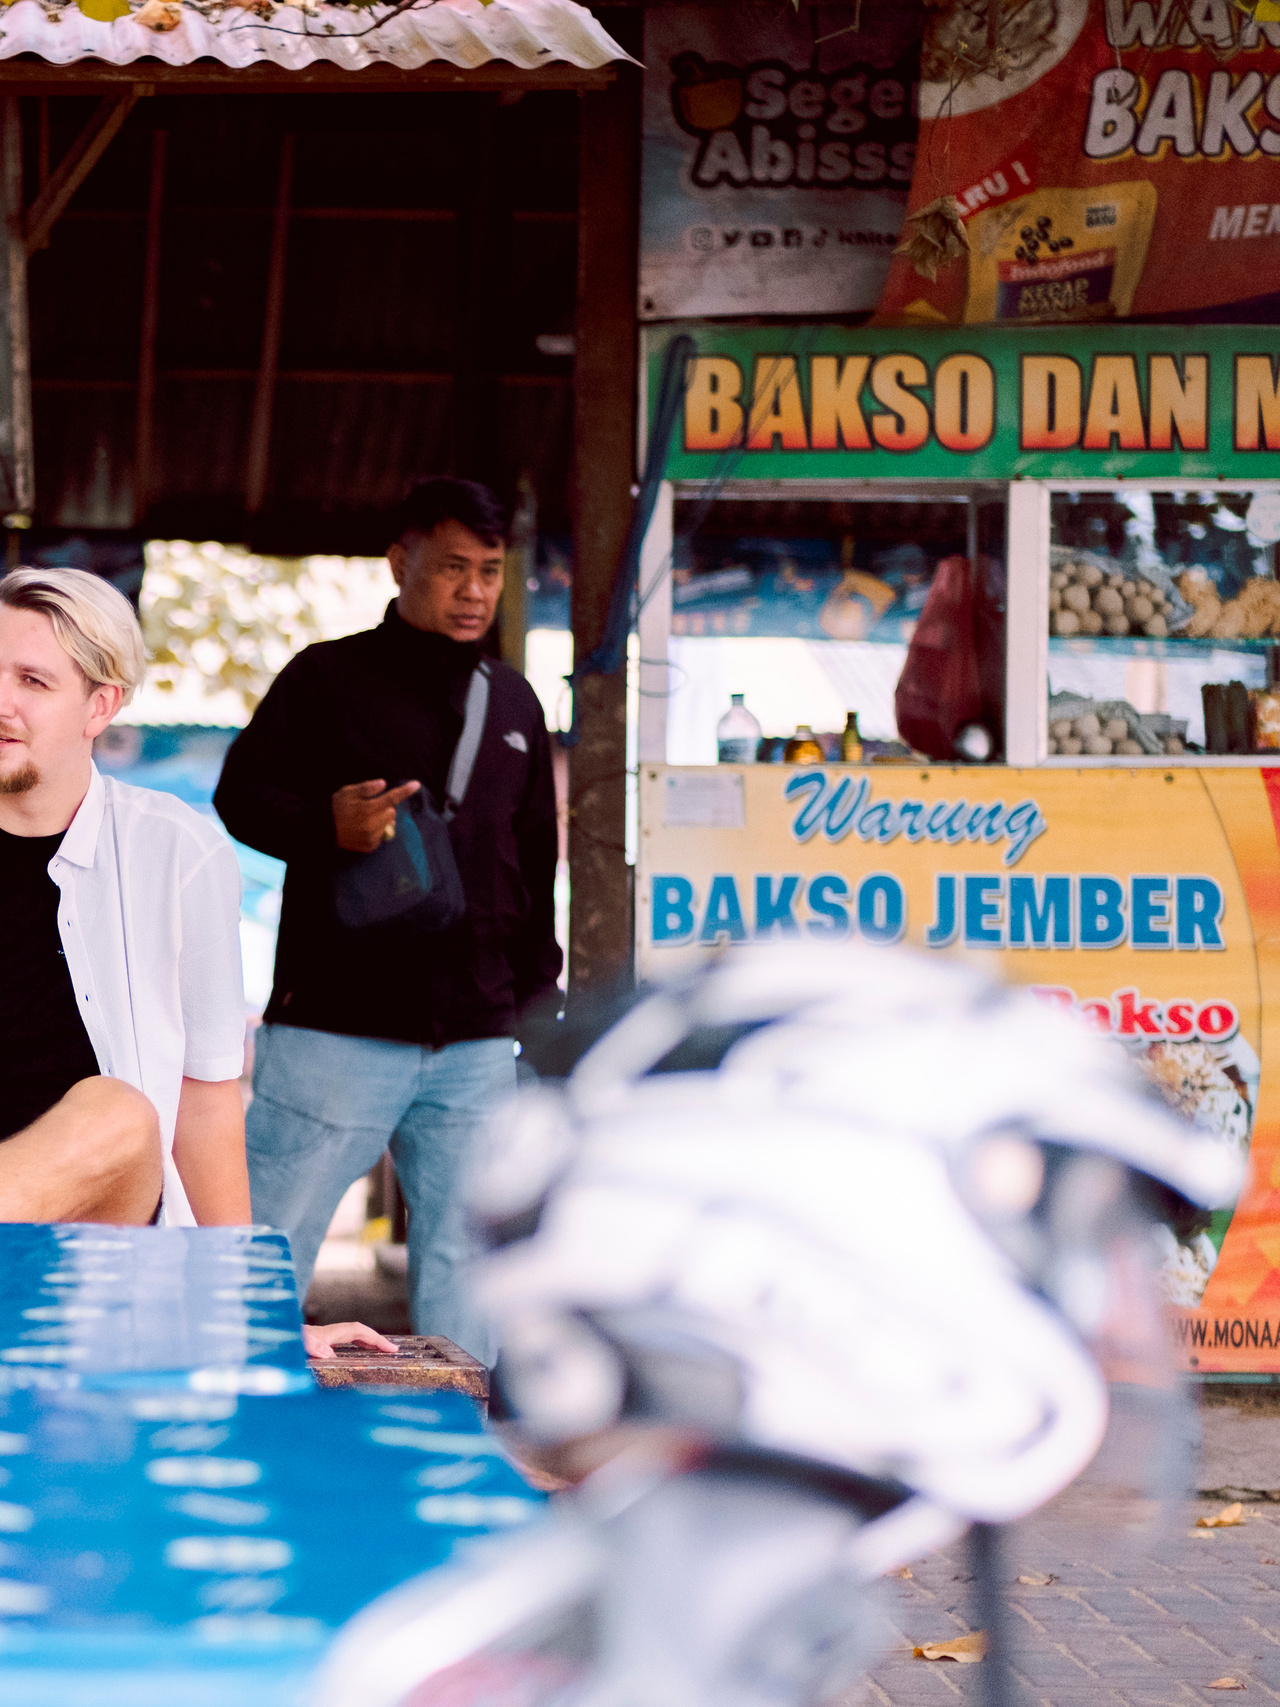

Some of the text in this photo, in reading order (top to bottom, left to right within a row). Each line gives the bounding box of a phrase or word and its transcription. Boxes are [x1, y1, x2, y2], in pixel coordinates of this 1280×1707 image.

[683, 353, 995, 452] BAKSO
[1020, 353, 1210, 452] DAN
[784, 771, 1047, 866] Warung
[650, 872, 1226, 951] BAKSO JEMBER
